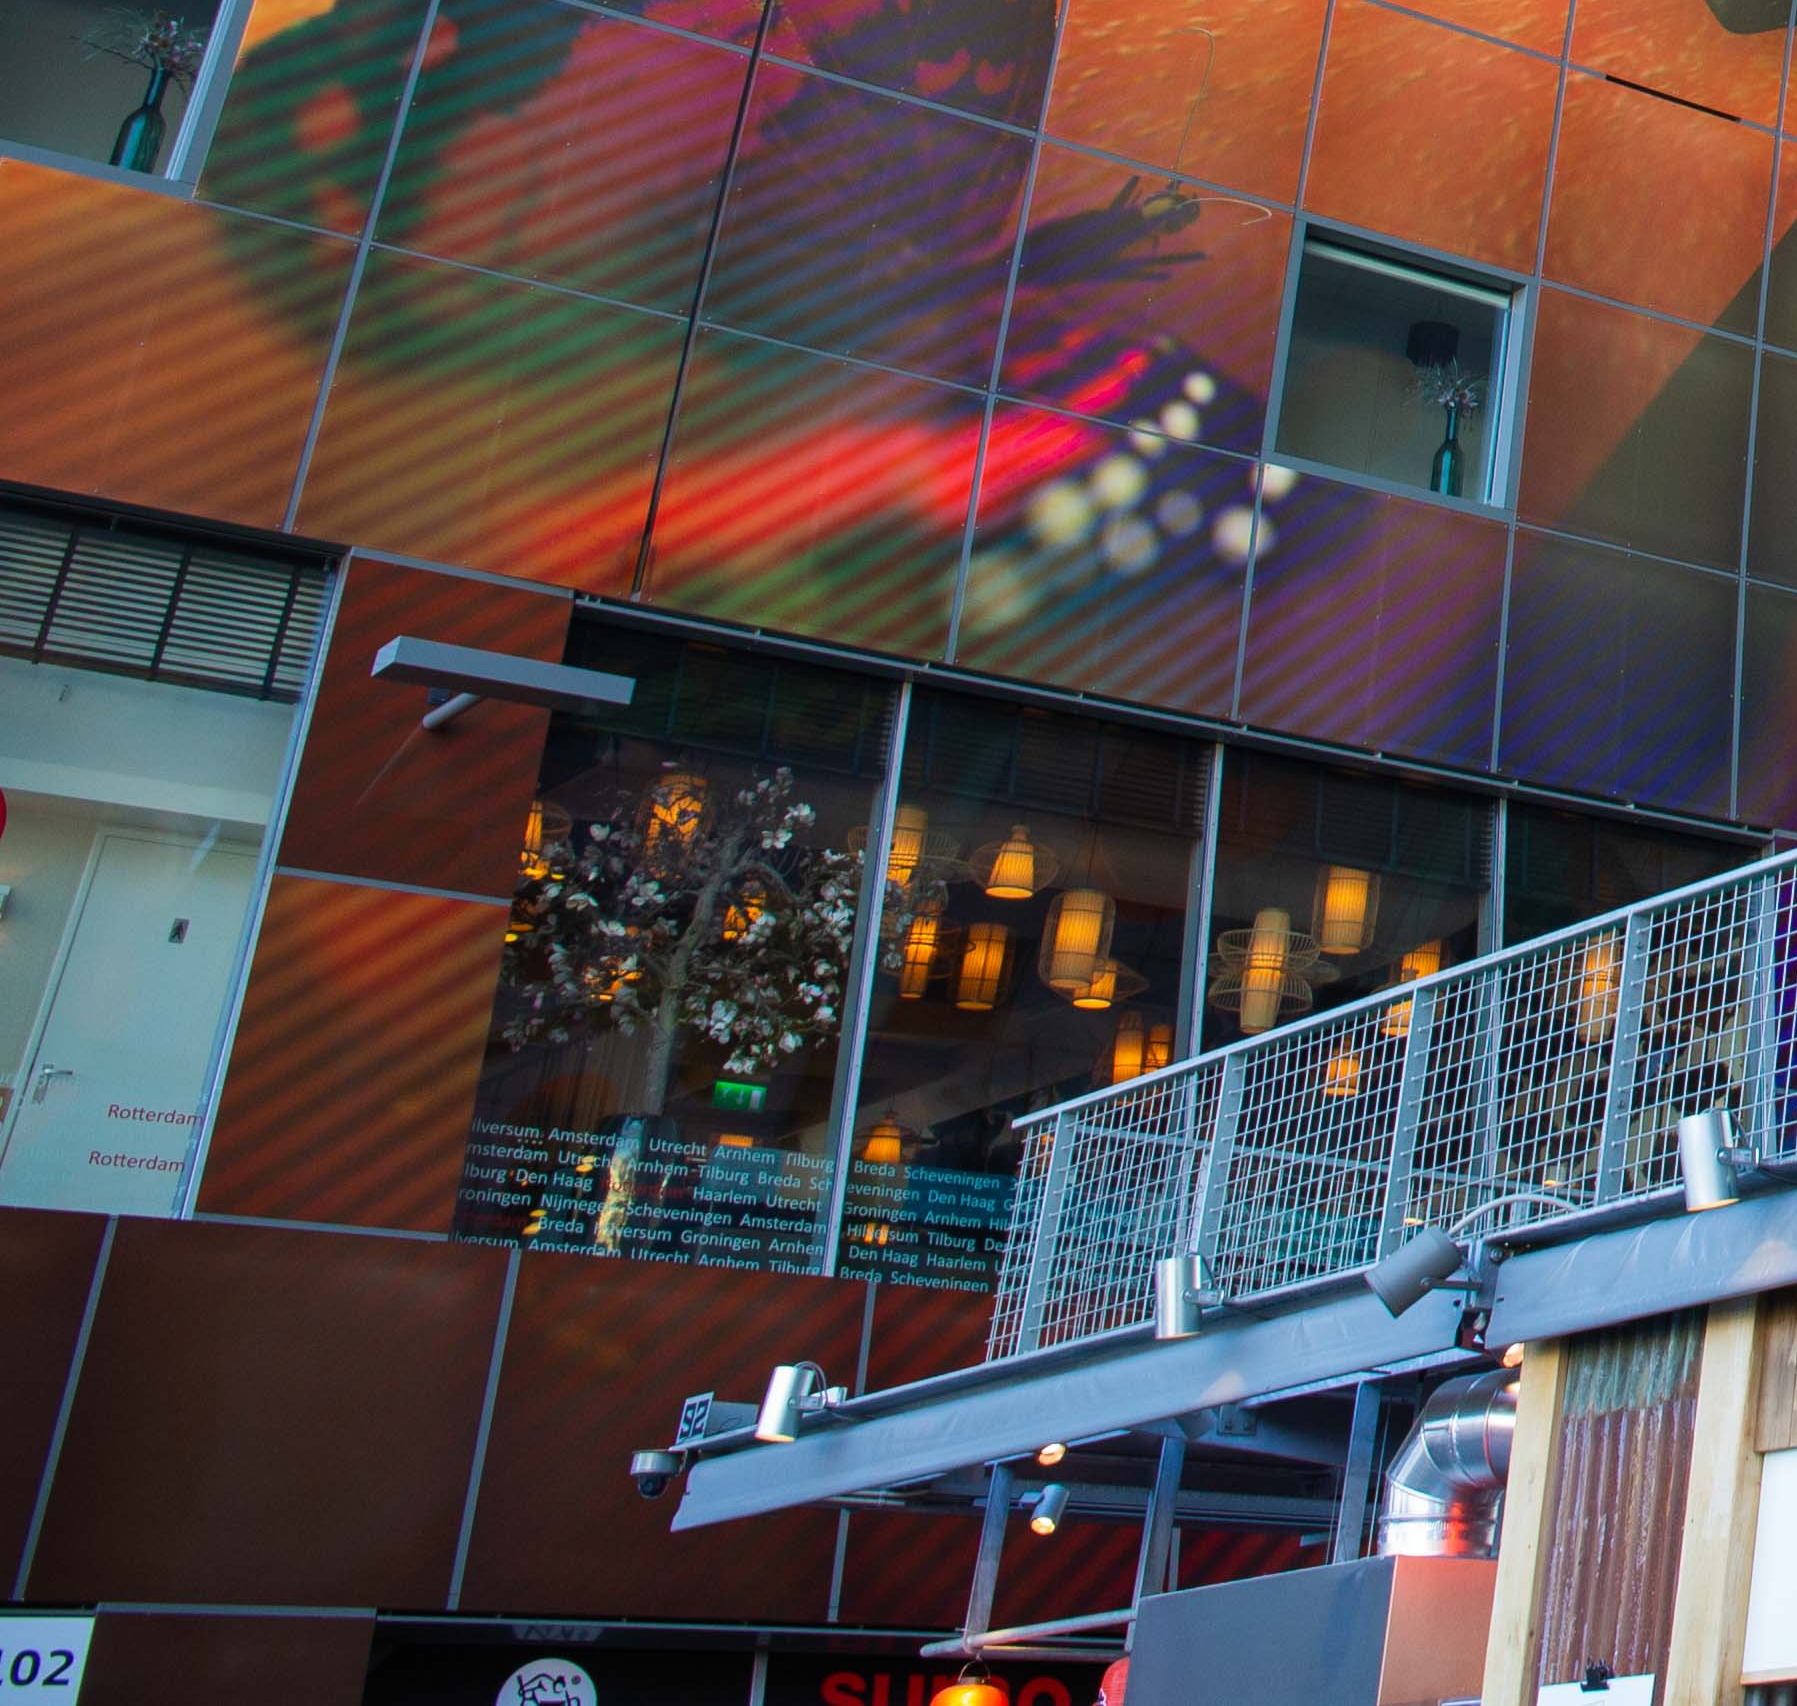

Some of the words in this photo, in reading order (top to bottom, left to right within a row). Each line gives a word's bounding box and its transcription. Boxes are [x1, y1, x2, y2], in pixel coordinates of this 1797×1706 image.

[107, 1103, 203, 1126] Rotterdam
[88, 1151, 186, 1172] Rotterdam
[548, 1128, 639, 1149] Amsterdam
[649, 1138, 707, 1156] Utrecht
[714, 1145, 775, 1164] Arnhem
[854, 1161, 896, 1177] Breda
[904, 1166, 1000, 1189] Scheveningen
[558, 1150, 617, 1169] Utrch
[627, 1157, 688, 1176] Arnhem
[697, 1165, 750, 1185] Tilburg
[758, 1172, 801, 1189] Breda
[928, 1190, 956, 1204] Den
[960, 1193, 995, 1212] Haag
[516, 1168, 547, 1184] Den
[552, 1172, 593, 1191] Haag
[693, 1186, 756, 1206] Haarlem
[766, 1194, 822, 1212] Utrecht
[924, 1210, 981, 1228] Arnhem
[541, 1194, 618, 1215] Nijmege
[740, 1214, 827, 1234] Amsterdam
[927, 1231, 976, 1251] Tilburg
[538, 1217, 584, 1233] Breda
[681, 1230, 760, 1250] Groningen
[849, 1245, 878, 1260] Den
[882, 1248, 919, 1268] Haag
[926, 1252, 986, 1271] Haarlem
[840, 1266, 882, 1282] Breda
[890, 1271, 989, 1293] Scheveningen
[0, 1650, 75, 1687] 02
